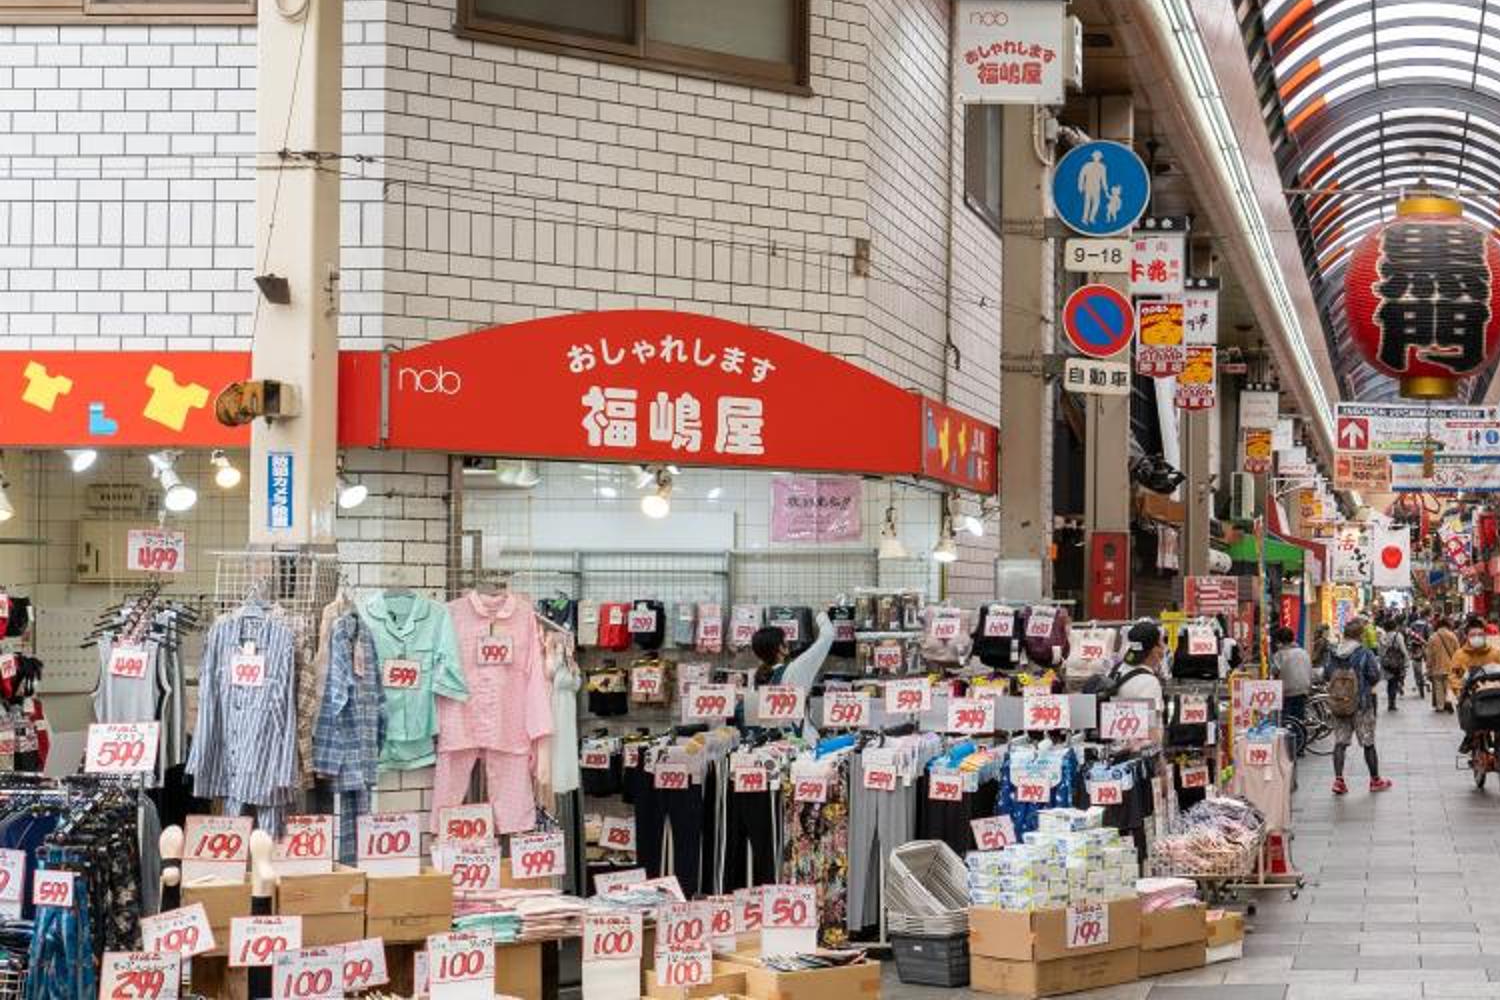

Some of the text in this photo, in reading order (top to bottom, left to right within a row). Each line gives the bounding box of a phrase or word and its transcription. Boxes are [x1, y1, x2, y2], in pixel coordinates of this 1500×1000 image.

[964, 40, 1057, 64] おしゃれします
[567, 334, 777, 383] おしゃれします
[399, 365, 461, 396] nob
[1068, 366, 1128, 388] 自動車
[581, 385, 766, 456] 福嶋屋
[482, 645, 508, 661] 999
[236, 664, 261, 683] 999
[389, 667, 417, 686] 599
[696, 696, 727, 714] 999
[1110, 718, 1140, 736] 199
[96, 741, 145, 766] 599
[660, 771, 684, 787] 999
[194, 833, 243, 858] 199
[368, 830, 411, 855] 100
[521, 850, 555, 874] 999
[451, 864, 491, 889] 599
[40, 881, 69, 900] 599
[772, 901, 807, 925] 50
[594, 931, 633, 955] 100
[667, 918, 702, 944] 100
[1072, 921, 1101, 944] 199
[343, 958, 373, 983] 99
[439, 949, 485, 978] 100
[665, 960, 702, 985] 100
[284, 967, 333, 998] 100
